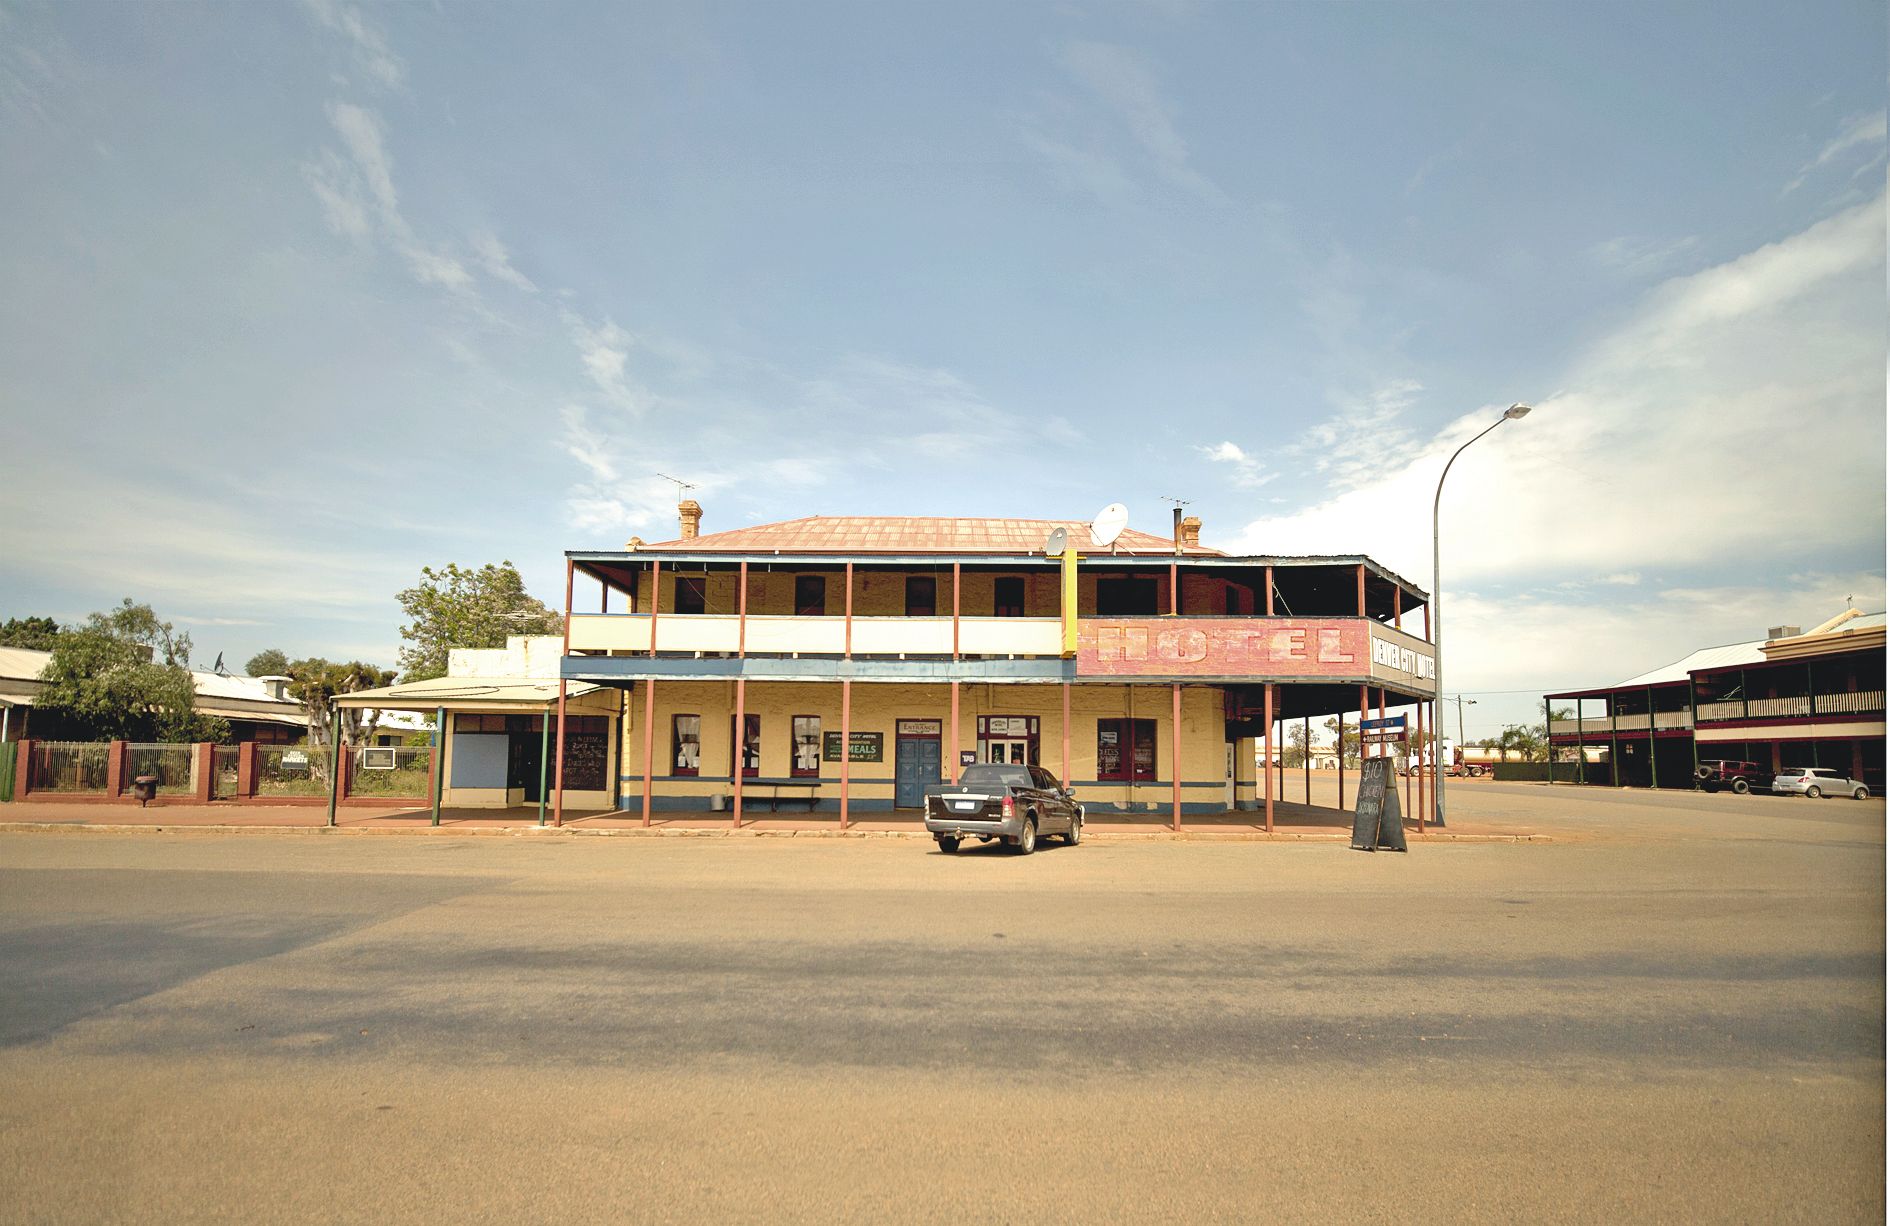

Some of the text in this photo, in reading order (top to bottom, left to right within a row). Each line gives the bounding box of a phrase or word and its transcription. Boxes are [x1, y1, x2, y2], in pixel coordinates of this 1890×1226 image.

[1097, 627, 1355, 663] HOTEL
[1372, 635, 1401, 670] DENVER
[1401, 647, 1417, 675] CITY
[1366, 733, 1399, 743] RAILWAY MUSEUM
[848, 745, 877, 754] MEALS
[1363, 760, 1383, 782] $10
